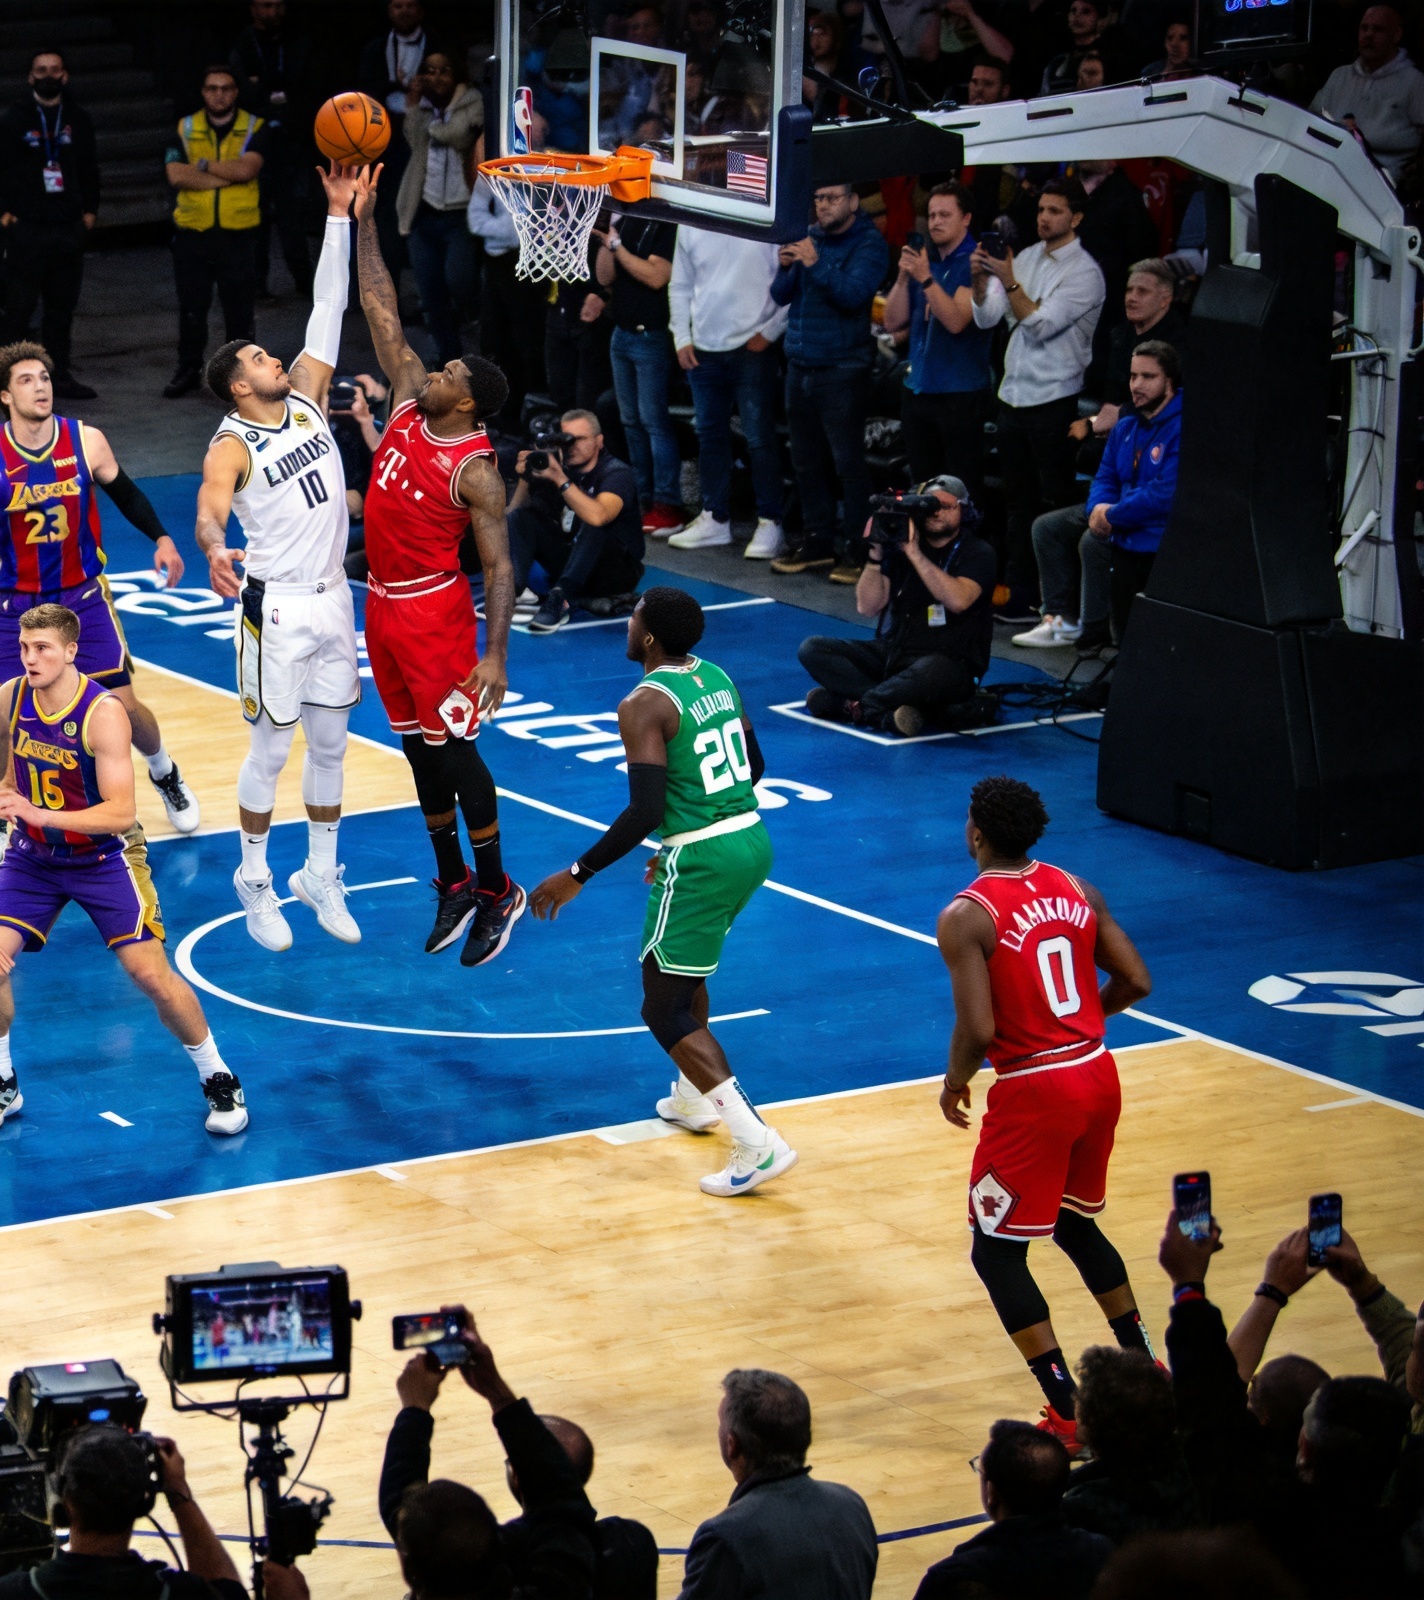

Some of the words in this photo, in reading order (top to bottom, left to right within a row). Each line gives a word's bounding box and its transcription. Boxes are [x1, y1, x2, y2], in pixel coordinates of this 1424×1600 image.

[297, 468, 329, 510] 10
[24, 504, 71, 545] 23
[693, 717, 752, 795] 20
[1037, 935, 1081, 1018] 0
